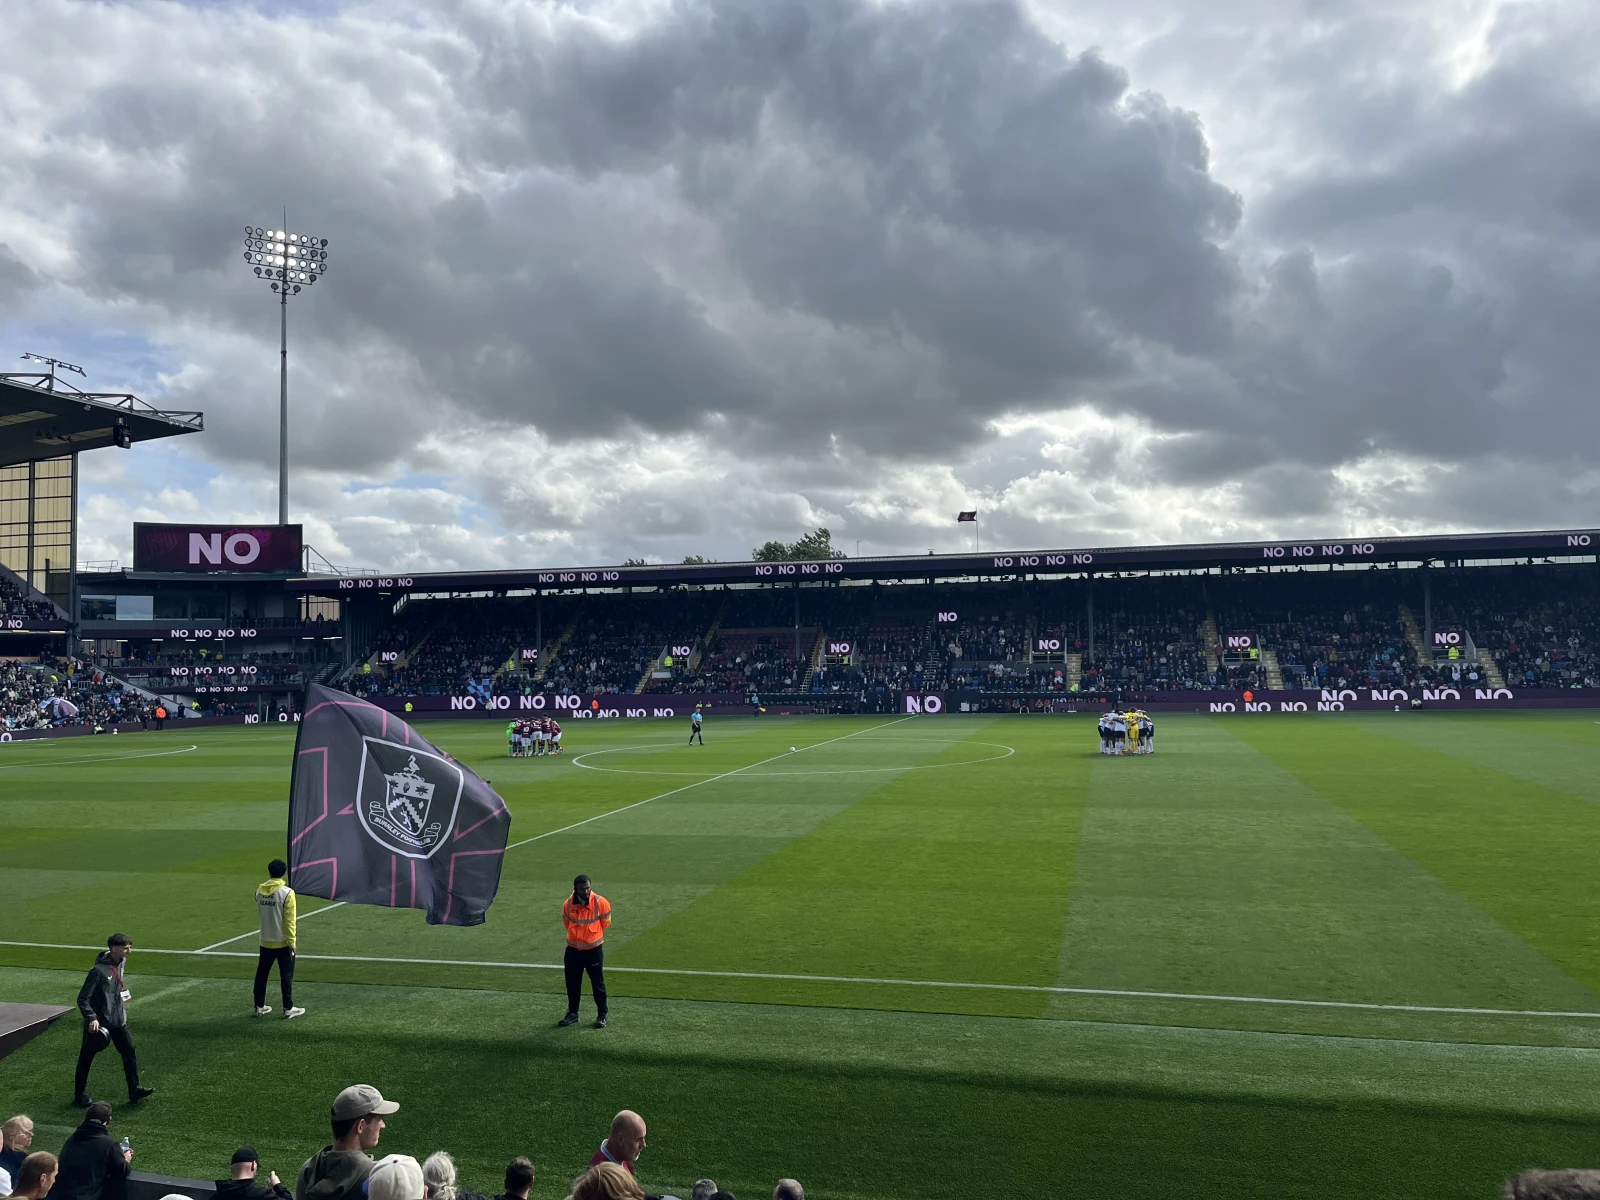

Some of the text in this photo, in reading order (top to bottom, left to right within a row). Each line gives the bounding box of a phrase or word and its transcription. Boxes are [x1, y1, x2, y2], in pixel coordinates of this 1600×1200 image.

[1567, 535, 1590, 546] NO
[189, 533, 260, 564] NO
[1263, 544, 1374, 557] NO NO NO NO
[994, 554, 1092, 568] NO NO NO NO
[755, 563, 843, 576] NO NO NO NO
[539, 572, 619, 583] NO NO NO NO
[339, 578, 413, 588] NO NO NO NO
[939, 612, 957, 621] NO
[8, 620, 22, 628] NO
[171, 629, 188, 637] NO
[218, 629, 235, 637] NO
[1435, 633, 1459, 643] NO
[1039, 640, 1059, 649] NO
[1229, 636, 1250, 648] NO
[673, 647, 690, 655] NO
[831, 643, 849, 652] NO
[382, 652, 397, 660] NO
[241, 666, 257, 674] NO
[452, 696, 475, 709] NO
[520, 695, 545, 709] NO
[555, 695, 581, 709] NO
[907, 696, 941, 714] NO
[1210, 701, 1344, 712] NO NO NO NO
[573, 708, 673, 718] NO NO NO NO
[245, 714, 258, 724] NO
[374, 817, 401, 836] BURNLEY
